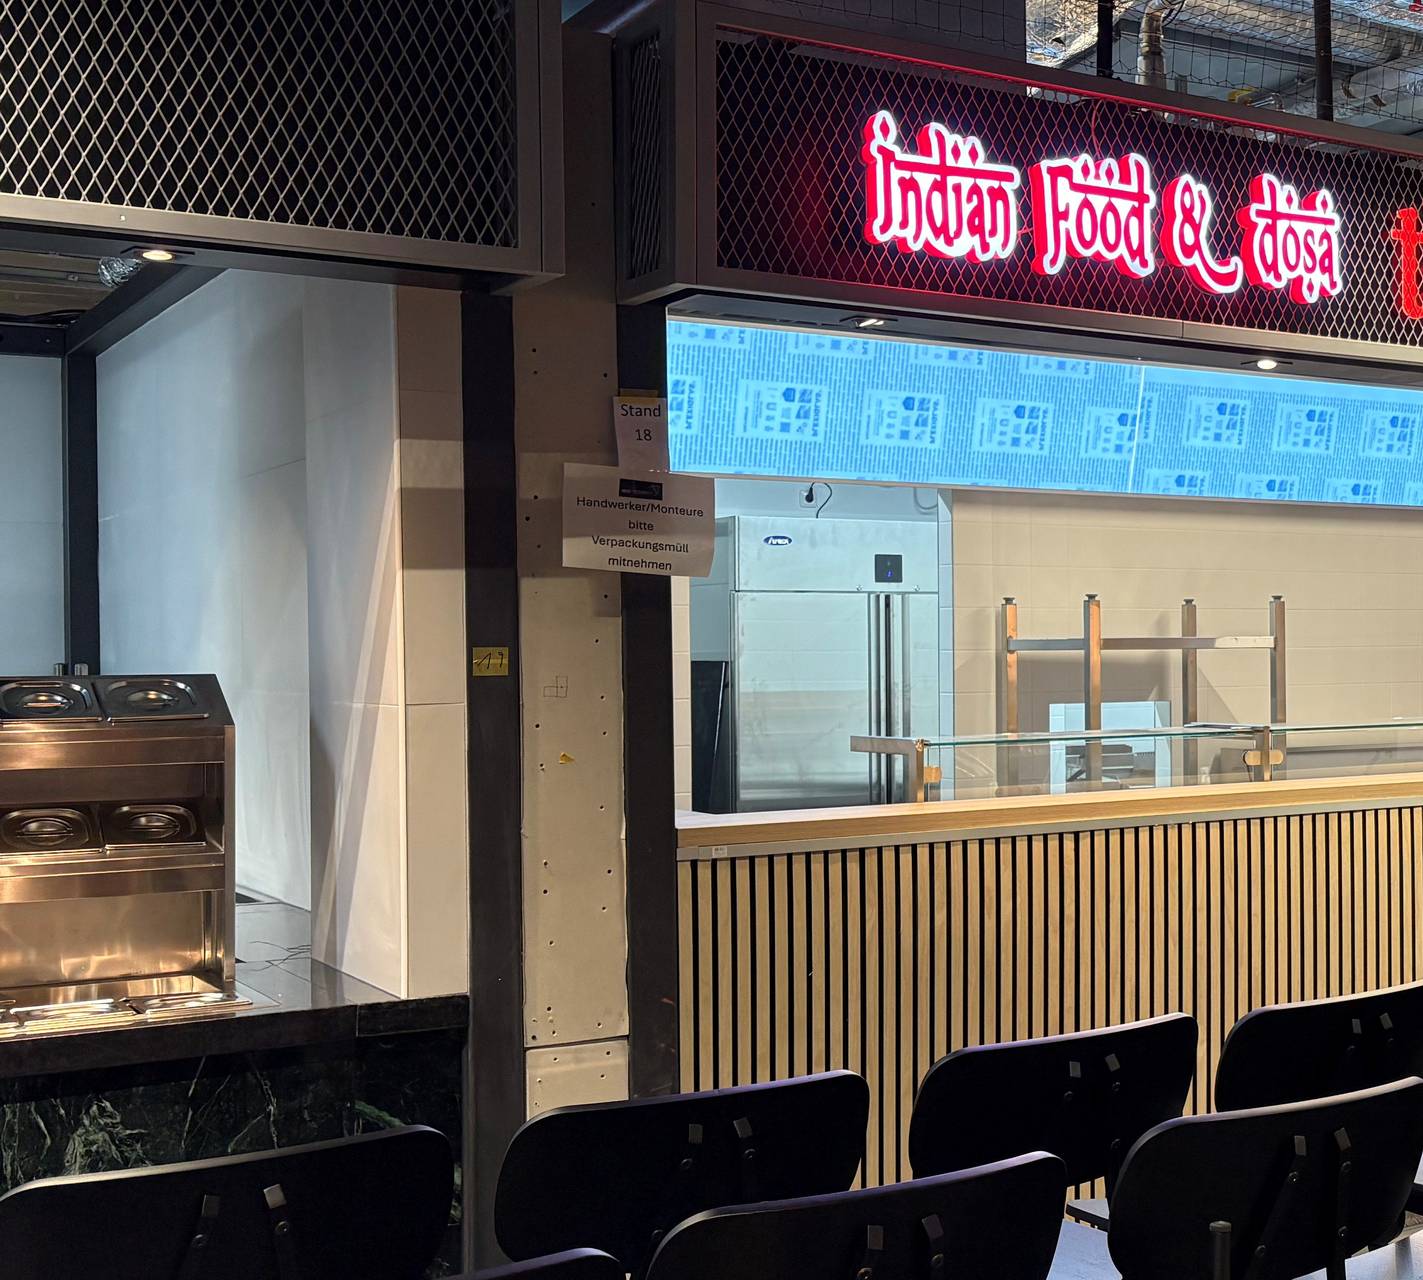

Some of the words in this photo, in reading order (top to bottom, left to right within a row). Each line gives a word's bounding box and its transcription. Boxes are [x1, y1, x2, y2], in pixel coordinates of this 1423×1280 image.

[1032, 152, 1156, 278] Food
[1162, 173, 1243, 295] &
[1238, 173, 1342, 303] dosa
[620, 404, 662, 417] Stand
[635, 428, 652, 441] 18
[576, 496, 704, 517] Handwerker/Monteure
[628, 519, 654, 532] bitte
[591, 535, 689, 553] Verpackungsmüll
[608, 556, 672, 571] mitnehmen
